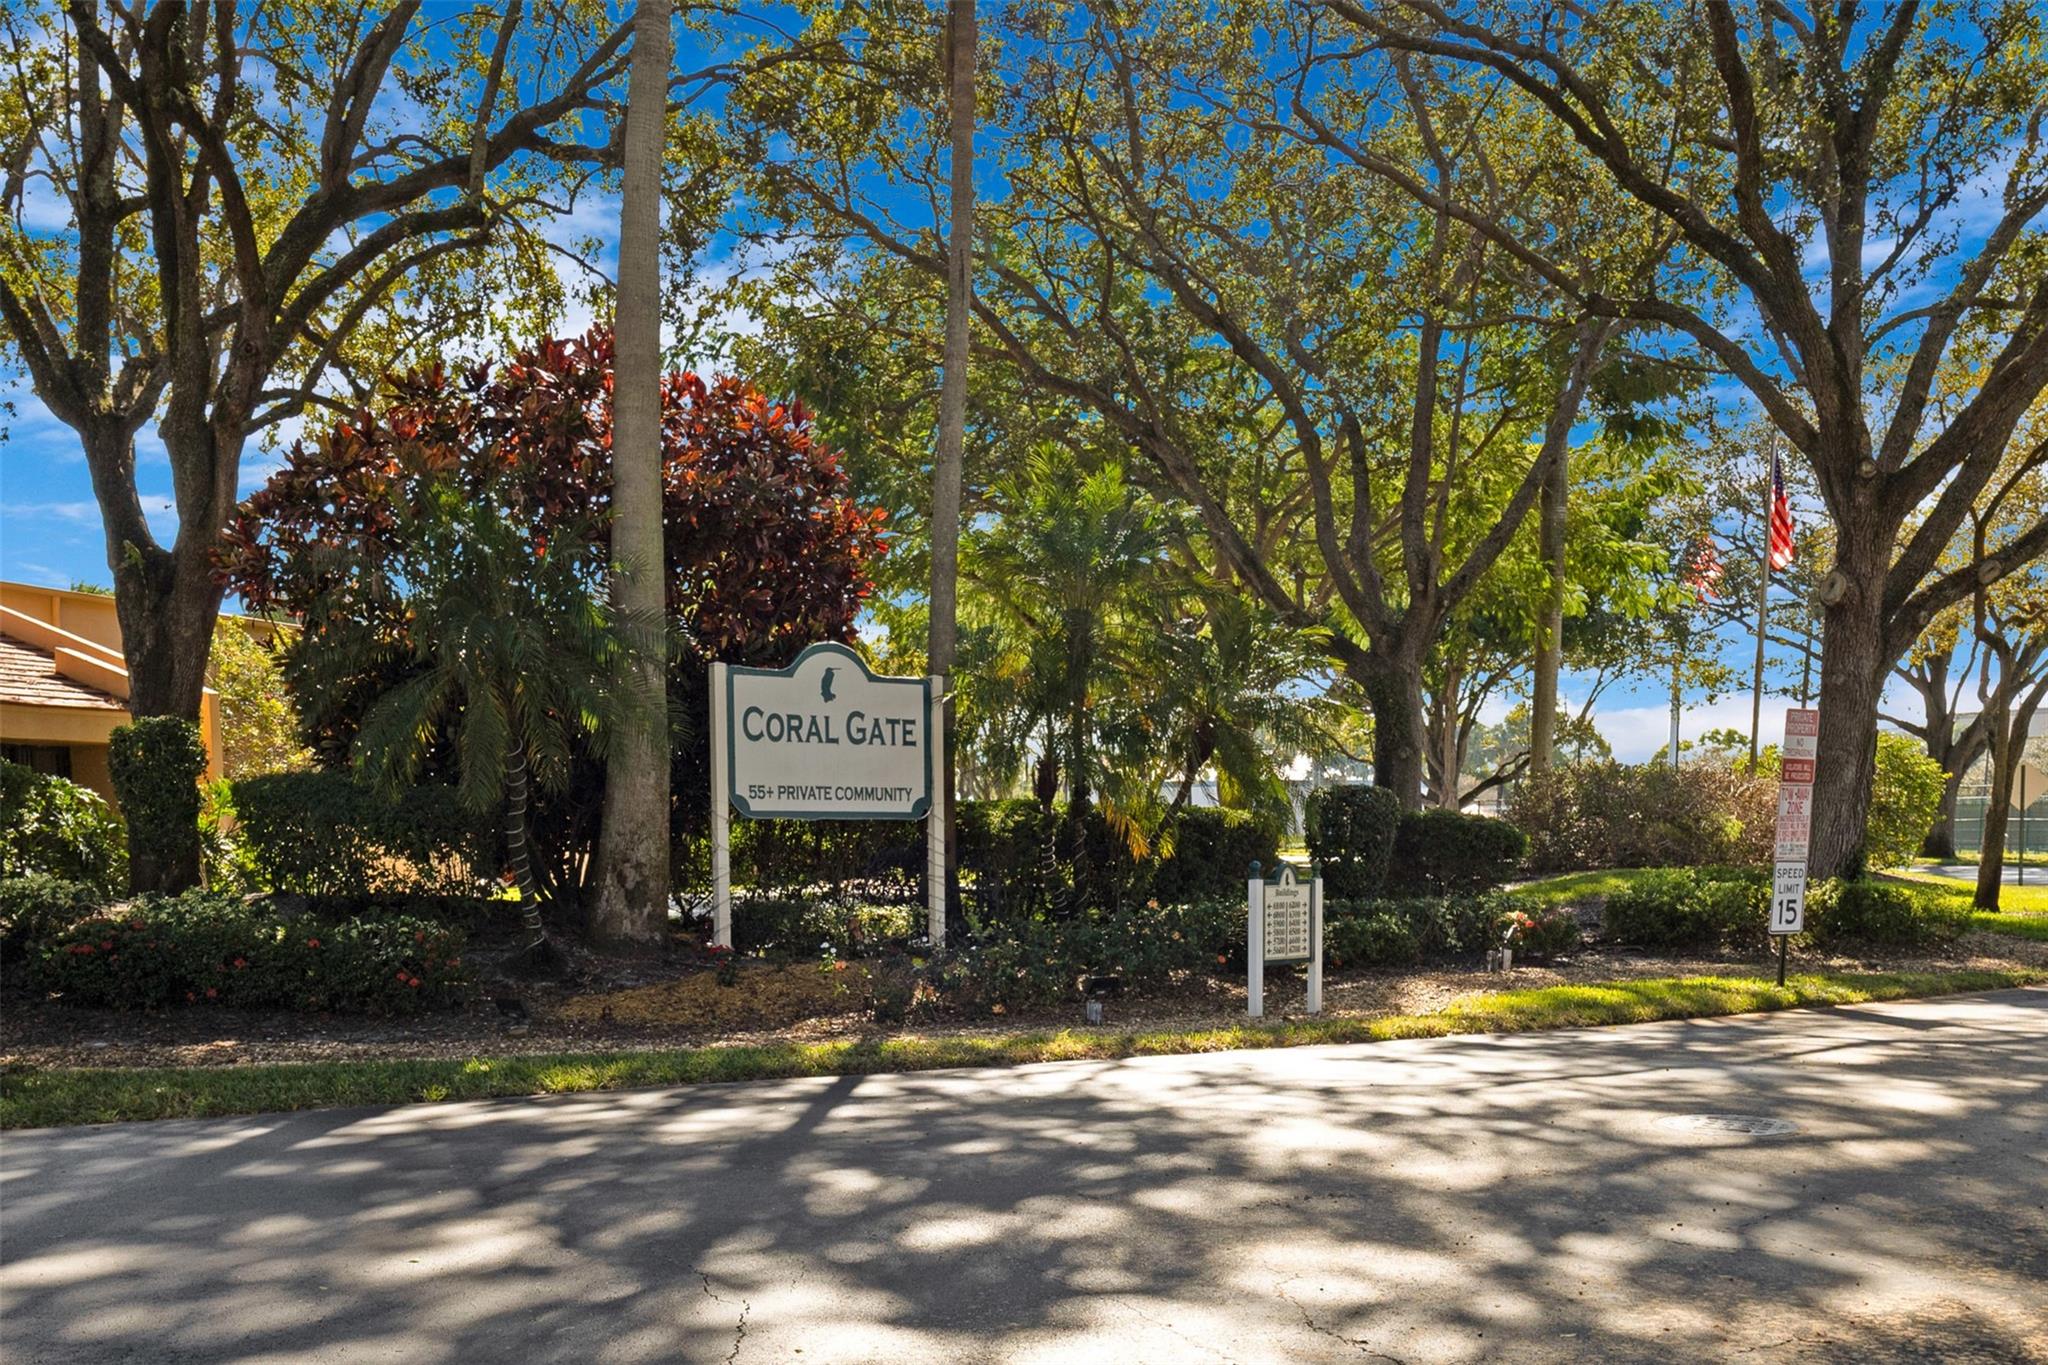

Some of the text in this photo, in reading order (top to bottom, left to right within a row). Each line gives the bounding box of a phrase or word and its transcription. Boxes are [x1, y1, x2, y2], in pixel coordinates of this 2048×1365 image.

[1790, 711, 1814, 722] PRIVATE
[742, 706, 917, 747] CORAL GATE
[1788, 722, 1816, 735] PROPERTY
[748, 784, 913, 802] 55+ PRIVATE COMMUNITY
[1787, 801, 1803, 815] ZONE
[1777, 868, 1804, 879] SPEED
[1778, 883, 1800, 894] LIMIT
[1778, 899, 1797, 925] 15
